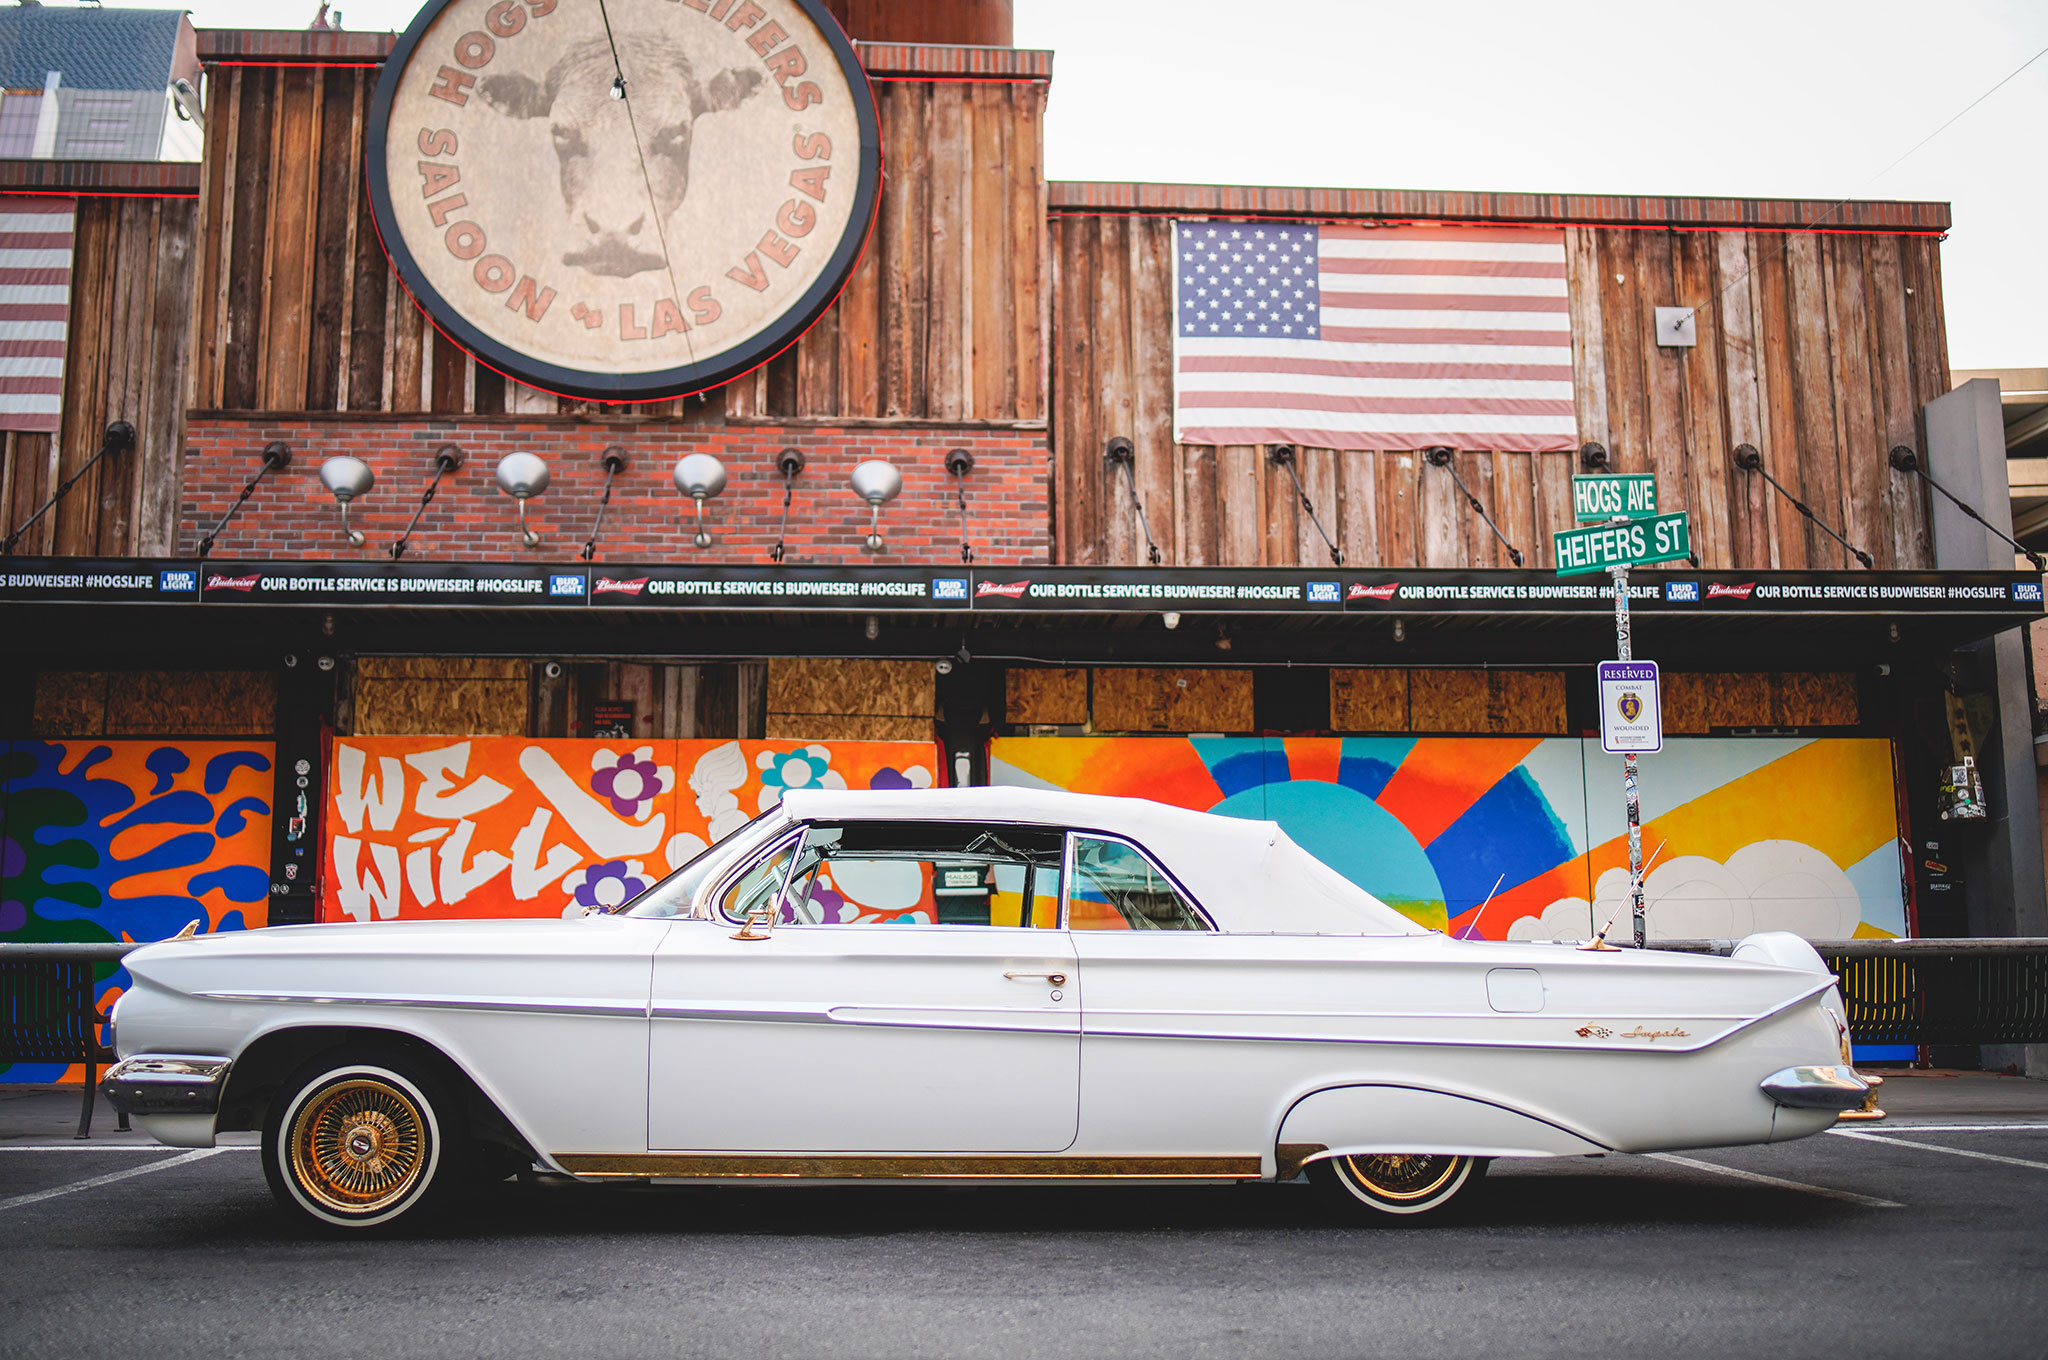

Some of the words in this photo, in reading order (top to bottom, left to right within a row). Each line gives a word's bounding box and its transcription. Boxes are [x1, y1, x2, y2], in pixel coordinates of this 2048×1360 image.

[667, 0, 823, 111] IFERS
[417, 126, 557, 323] SALOON
[619, 285, 723, 341] LAS
[725, 131, 832, 293] VEGAS
[1575, 480, 1622, 513] HOGS
[1628, 480, 1655, 511] AVE
[1557, 525, 1646, 569] HEIFERS
[1654, 519, 1682, 554] ST
[8, 575, 84, 588] BUDWEISER!
[85, 575, 153, 589] #HOGSLIFE
[163, 581, 193, 589] LIGHT
[207, 576, 256, 588] Budweiser
[260, 577, 288, 591] OUR
[289, 577, 336, 591] BOTTLE
[336, 577, 386, 592] SERVICE
[386, 578, 399, 592] IS
[399, 578, 475, 593] BUDWEISER!
[475, 578, 543, 593] #HOGSLIFE
[552, 585, 582, 593] LIGHT
[596, 580, 644, 591] Budweiser
[648, 580, 676, 595] OUR
[676, 581, 723, 595] BOTTLE
[722, 581, 772, 595] SERVICE
[772, 581, 785, 596] IS
[785, 582, 860, 596] BUDWEISER!
[860, 582, 927, 597] #HOGSLIFE
[978, 583, 1026, 594] Budweiser
[935, 589, 965, 597] LIGHT
[1029, 584, 1057, 598] OUR
[1057, 584, 1102, 598] BOTTLE
[1102, 584, 1151, 598] SERVICE
[1151, 584, 1164, 598] IS
[1163, 585, 1236, 599] BUDWEISER!
[1236, 585, 1301, 600] #HOGSLIFE
[1310, 592, 1338, 600] LIGHT
[1349, 585, 1395, 596] Budweiser
[1399, 586, 1426, 600] OUR
[1426, 586, 1469, 599] BOTTLE
[1469, 586, 1516, 599] SERVICE
[1516, 586, 1528, 599] IS
[1528, 585, 1598, 599] BUDWEISER!
[1599, 586, 1660, 599] #HSLIFE
[1708, 585, 1752, 596] Budweiser
[1756, 585, 1781, 598] OUR
[1782, 585, 1823, 598] BOTTLE
[1823, 586, 1868, 599] SERVICE
[1868, 586, 1879, 598] IS
[1880, 586, 1946, 599] BUDWEISER!
[1947, 586, 2007, 599] #HOGSLIFE
[1604, 669, 1654, 679] RESERVED
[1620, 1025, 1691, 1042] Impala
